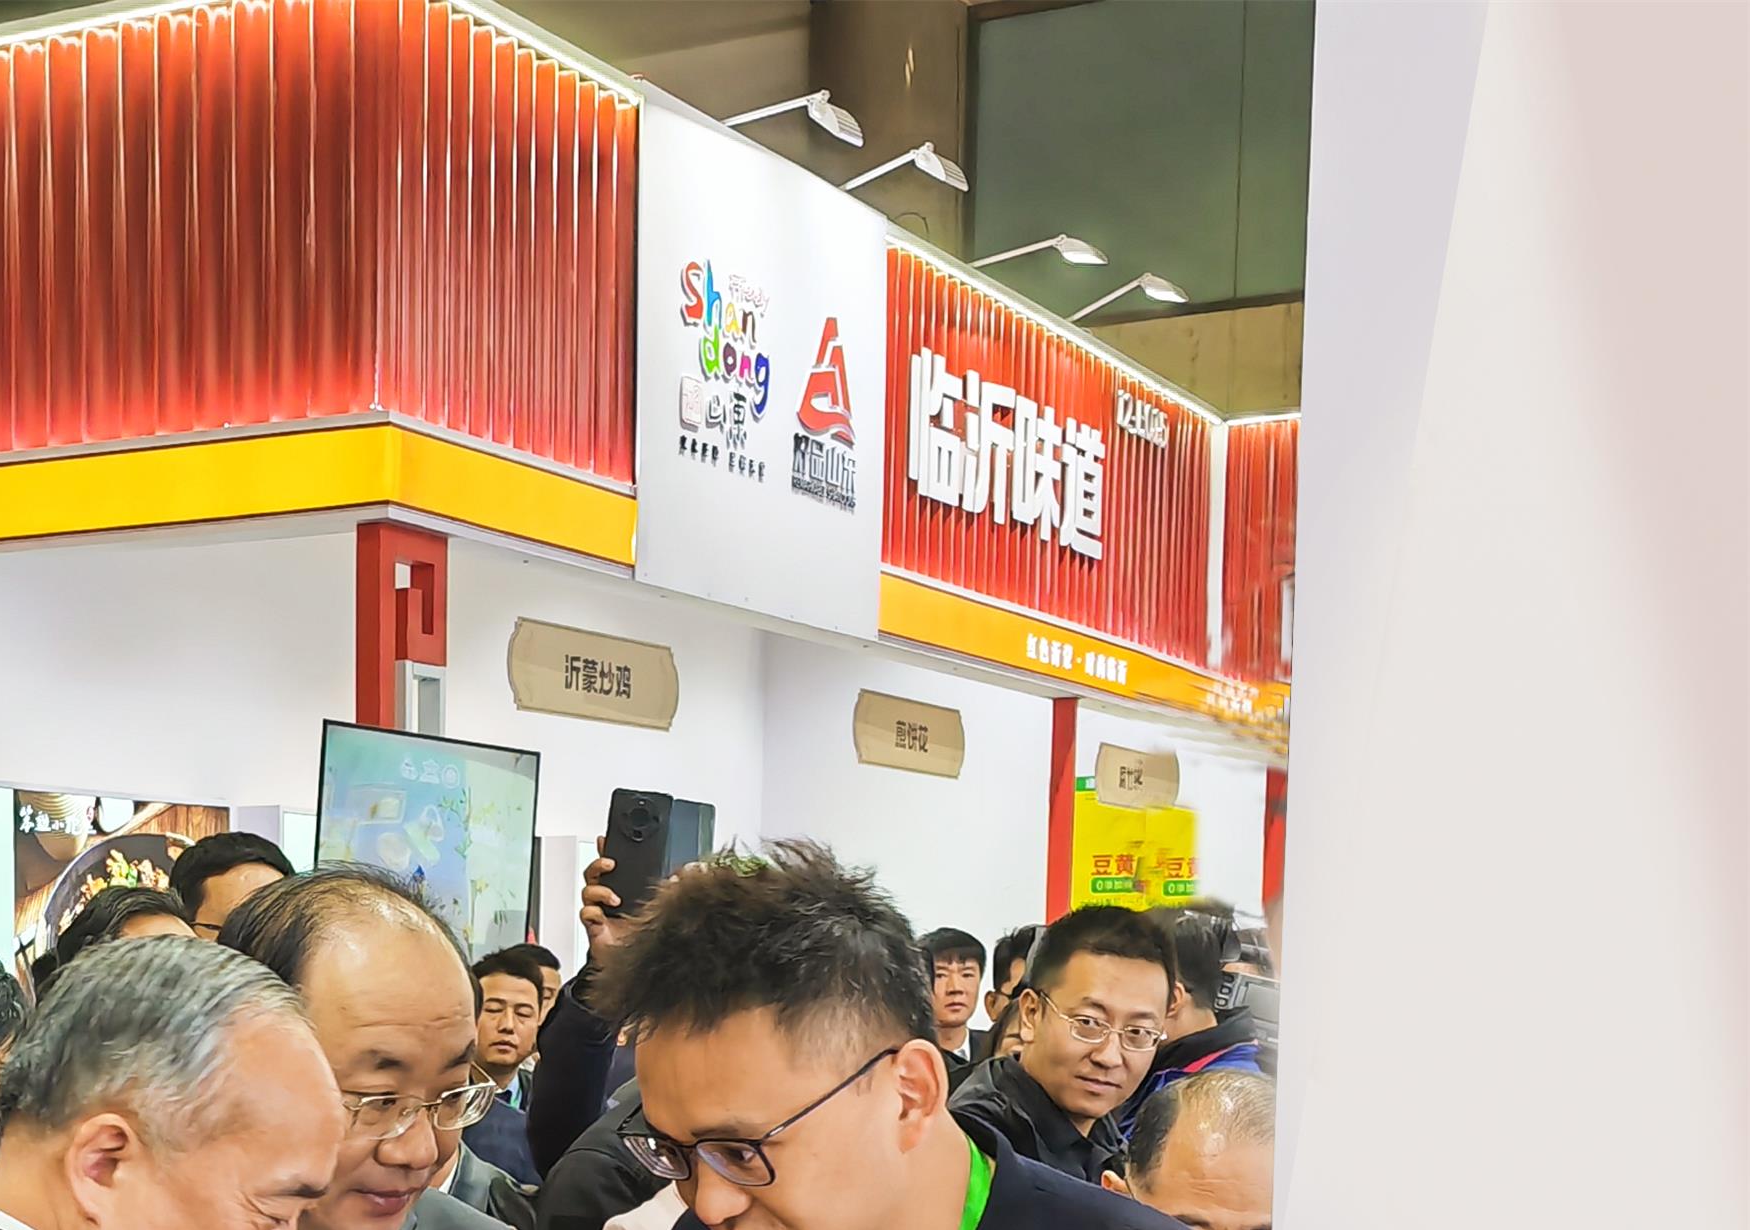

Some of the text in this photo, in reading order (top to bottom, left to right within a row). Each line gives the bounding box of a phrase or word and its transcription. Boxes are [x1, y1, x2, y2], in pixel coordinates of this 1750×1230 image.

[681, 260, 758, 344] Shan
[907, 347, 1106, 560] 临沂味道
[564, 653, 632, 699] 沂蒙炒鸡
